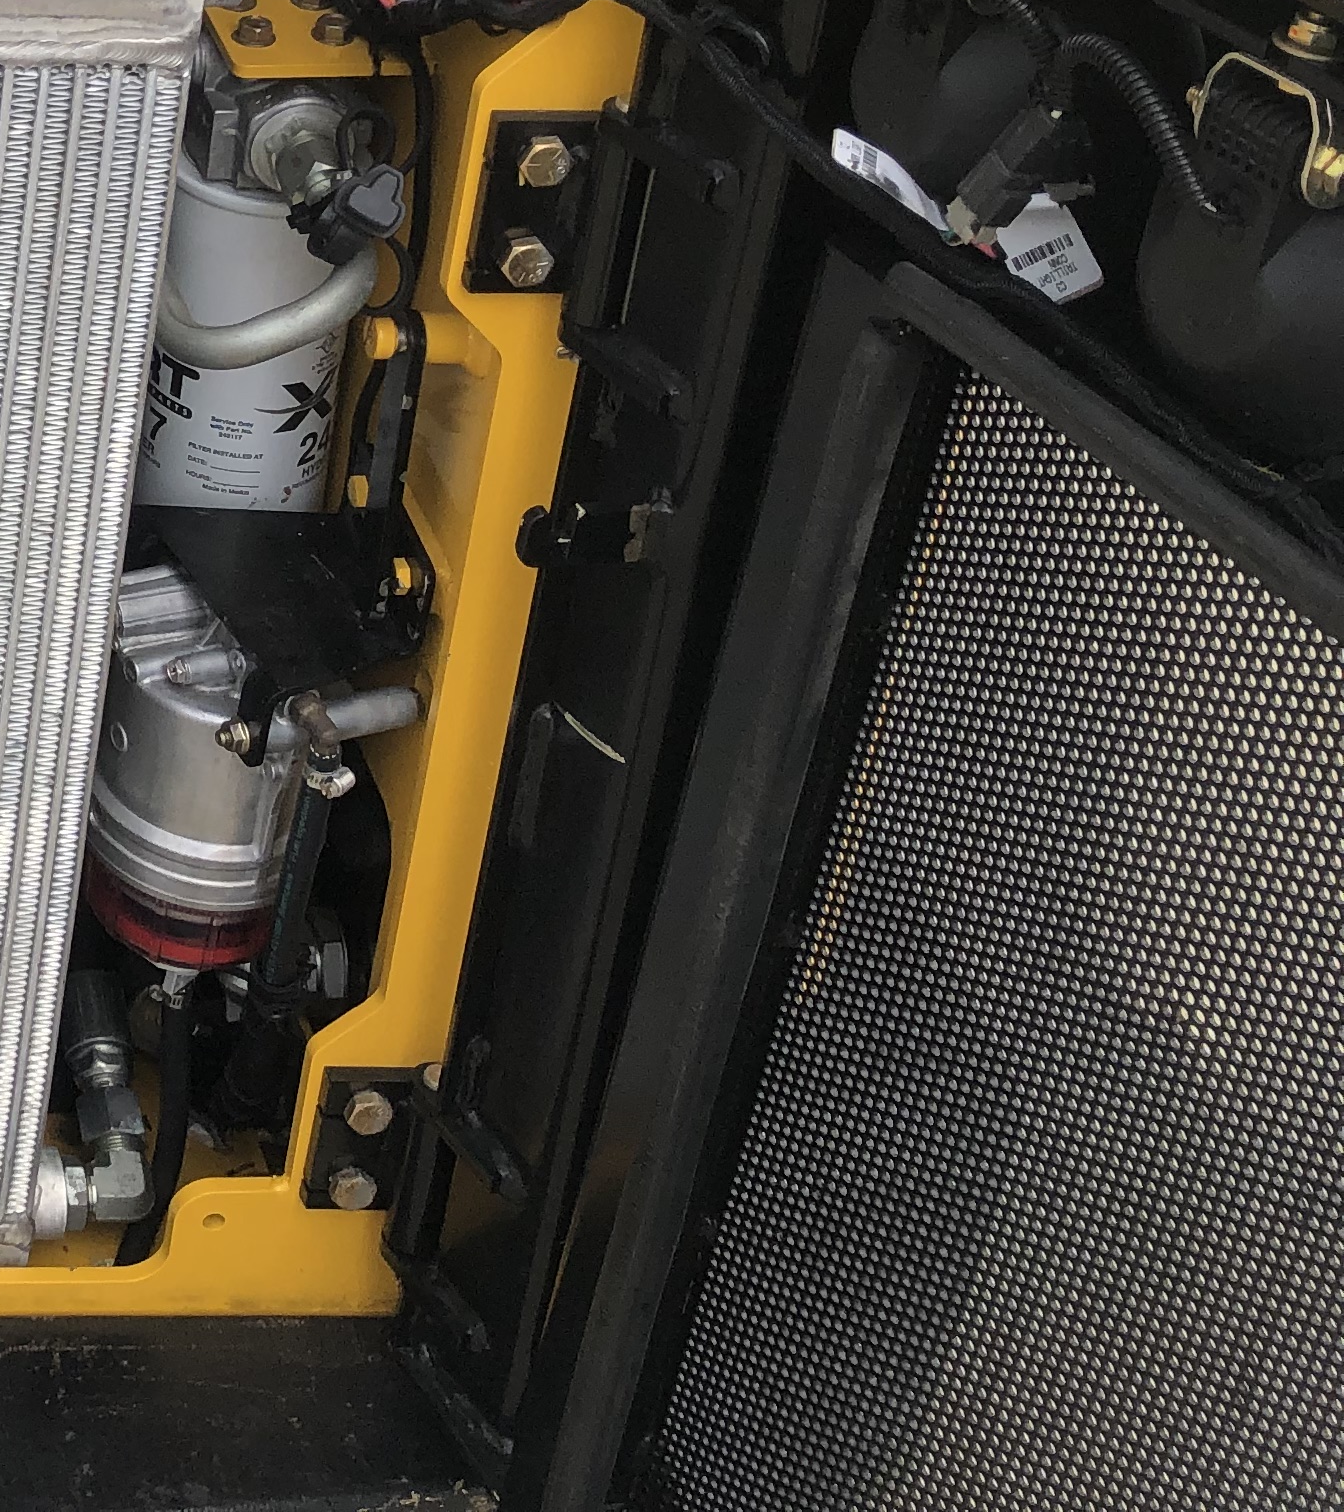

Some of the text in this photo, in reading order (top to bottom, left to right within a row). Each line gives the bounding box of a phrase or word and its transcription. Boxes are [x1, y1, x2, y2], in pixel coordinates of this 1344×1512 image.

[150, 345, 201, 400] RT
[150, 406, 167, 441] 7
[188, 441, 212, 454] FILTER
[212, 448, 253, 460] INSTALLED
[296, 418, 331, 468] 24
[187, 454, 208, 467] DATE:
[185, 469, 212, 482] HOURS:
[202, 483, 220, 492] Made
